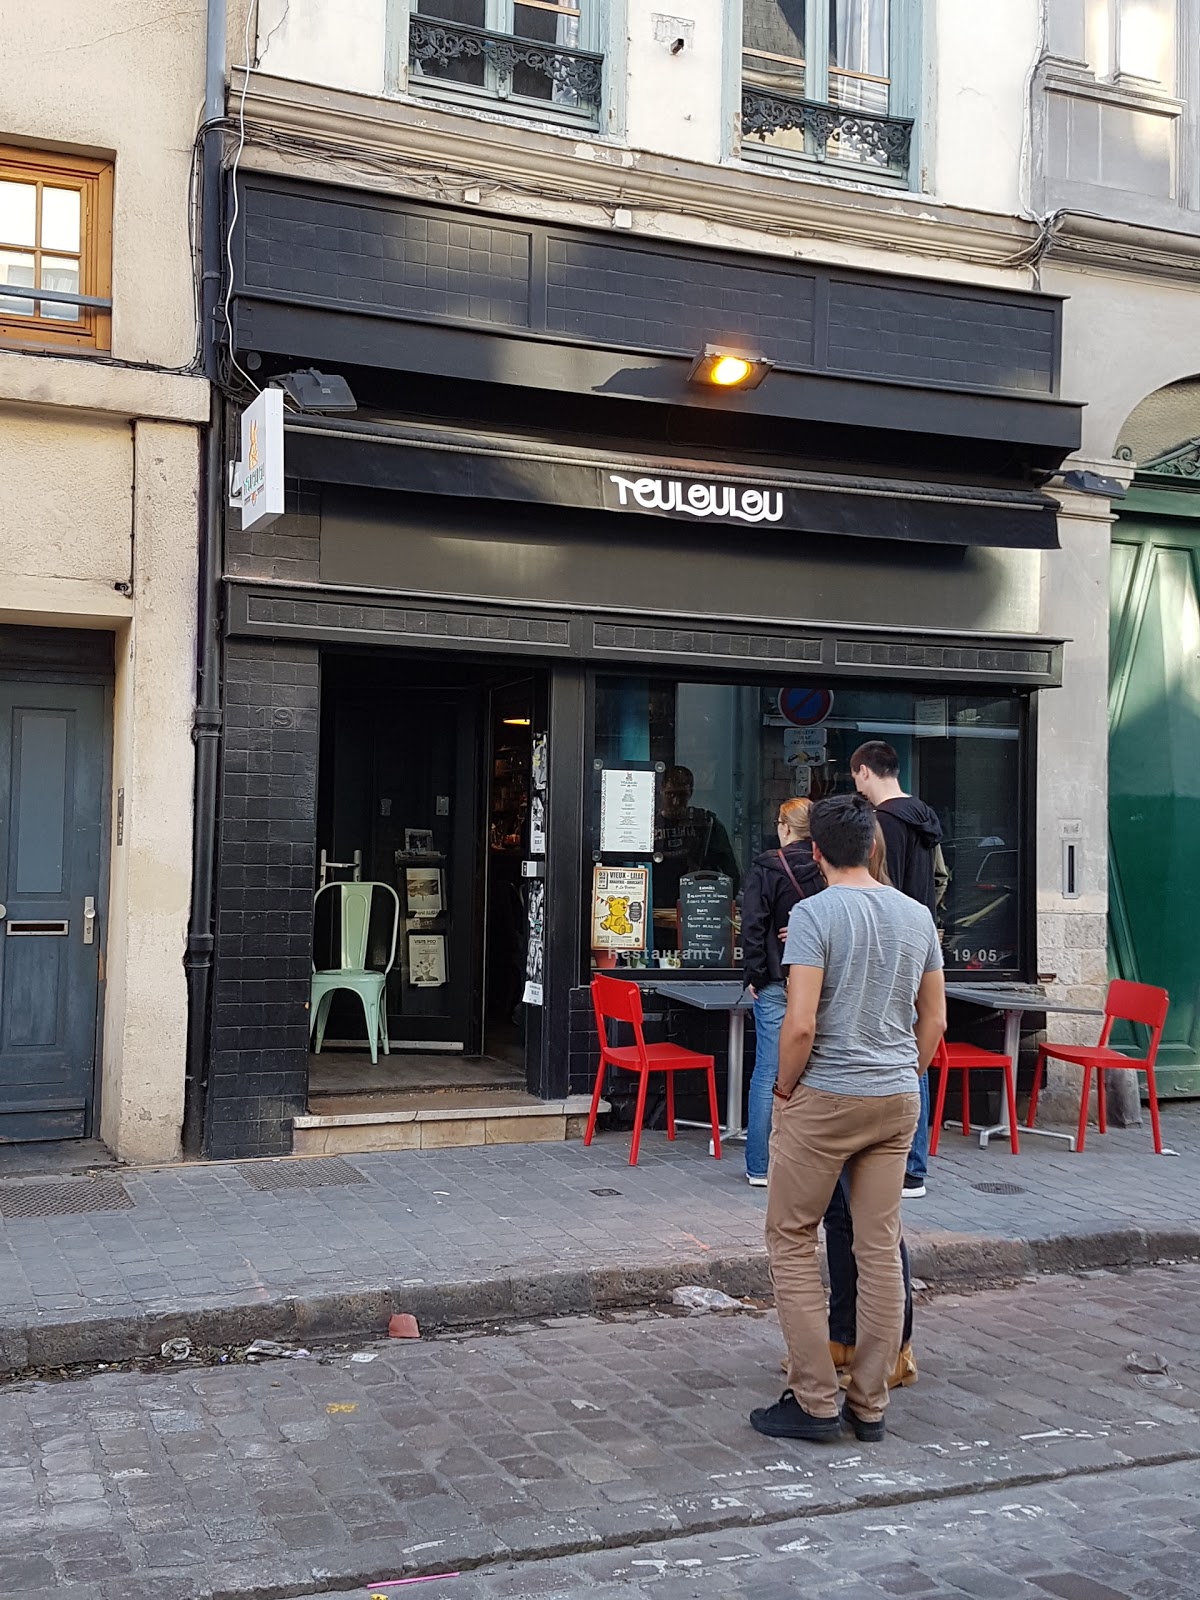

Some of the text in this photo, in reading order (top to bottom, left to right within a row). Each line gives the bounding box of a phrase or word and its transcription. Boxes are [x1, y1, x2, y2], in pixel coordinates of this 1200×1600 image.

[609, 475, 783, 522] TOULOULOU
[609, 871, 626, 879] VIEUX
[630, 872, 644, 880] LILLE
[608, 947, 711, 960] Restaurant
[734, 946, 744, 960] B
[953, 949, 971, 961] 19
[978, 949, 997, 962] 05
